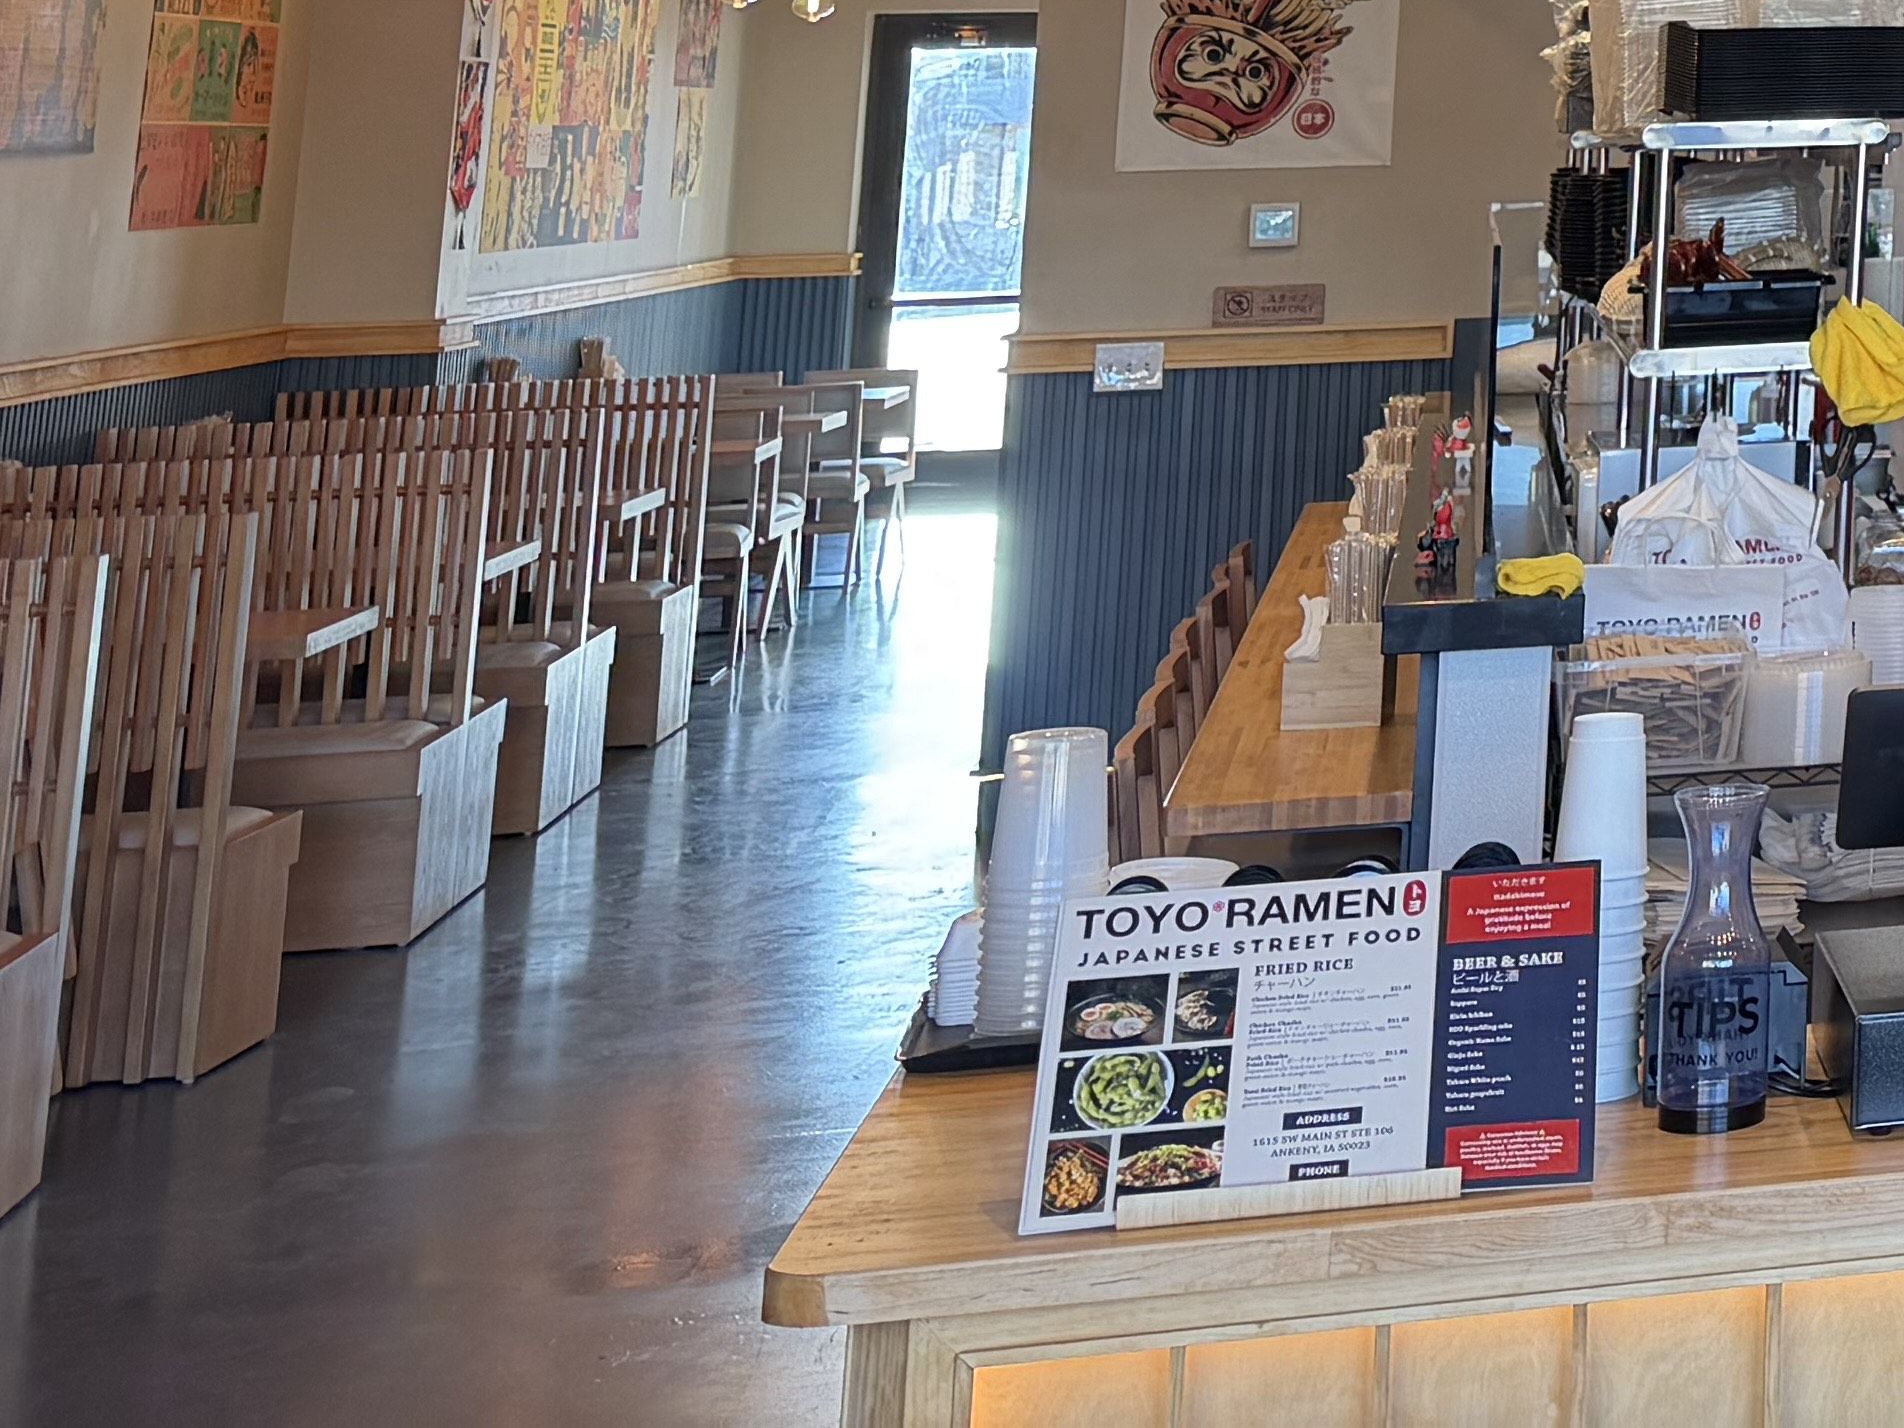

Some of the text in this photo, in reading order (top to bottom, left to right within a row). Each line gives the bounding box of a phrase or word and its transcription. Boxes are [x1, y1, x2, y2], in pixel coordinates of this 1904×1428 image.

[1076, 886, 1397, 940] TOYO RAMEN
[1466, 901, 1571, 916] A Japanese expression of
[1484, 912, 1552, 926] gratitude before
[1484, 924, 1522, 934] enjoying
[1530, 921, 1551, 930] meal
[1077, 927, 1422, 968] JAPANESE STREET FOOD
[1254, 958, 1354, 977] FRIED RICE
[1452, 951, 1564, 972] BEER & SAKE
[1254, 977, 1316, 992] チャーハン
[1452, 969, 1520, 986] ビールと酒
[1671, 996, 1760, 1039] TIPS
[1670, 1047, 1758, 1067] THANK YOU!
[1296, 1111, 1350, 1126] ADDRESS
[1252, 1126, 1393, 1147] 1615 SW MAIN ST STE 106
[1270, 1145, 1321, 1158] ANKENY,
[1338, 1140, 1371, 1152] 50023
[1298, 1164, 1340, 1177] PHONE
